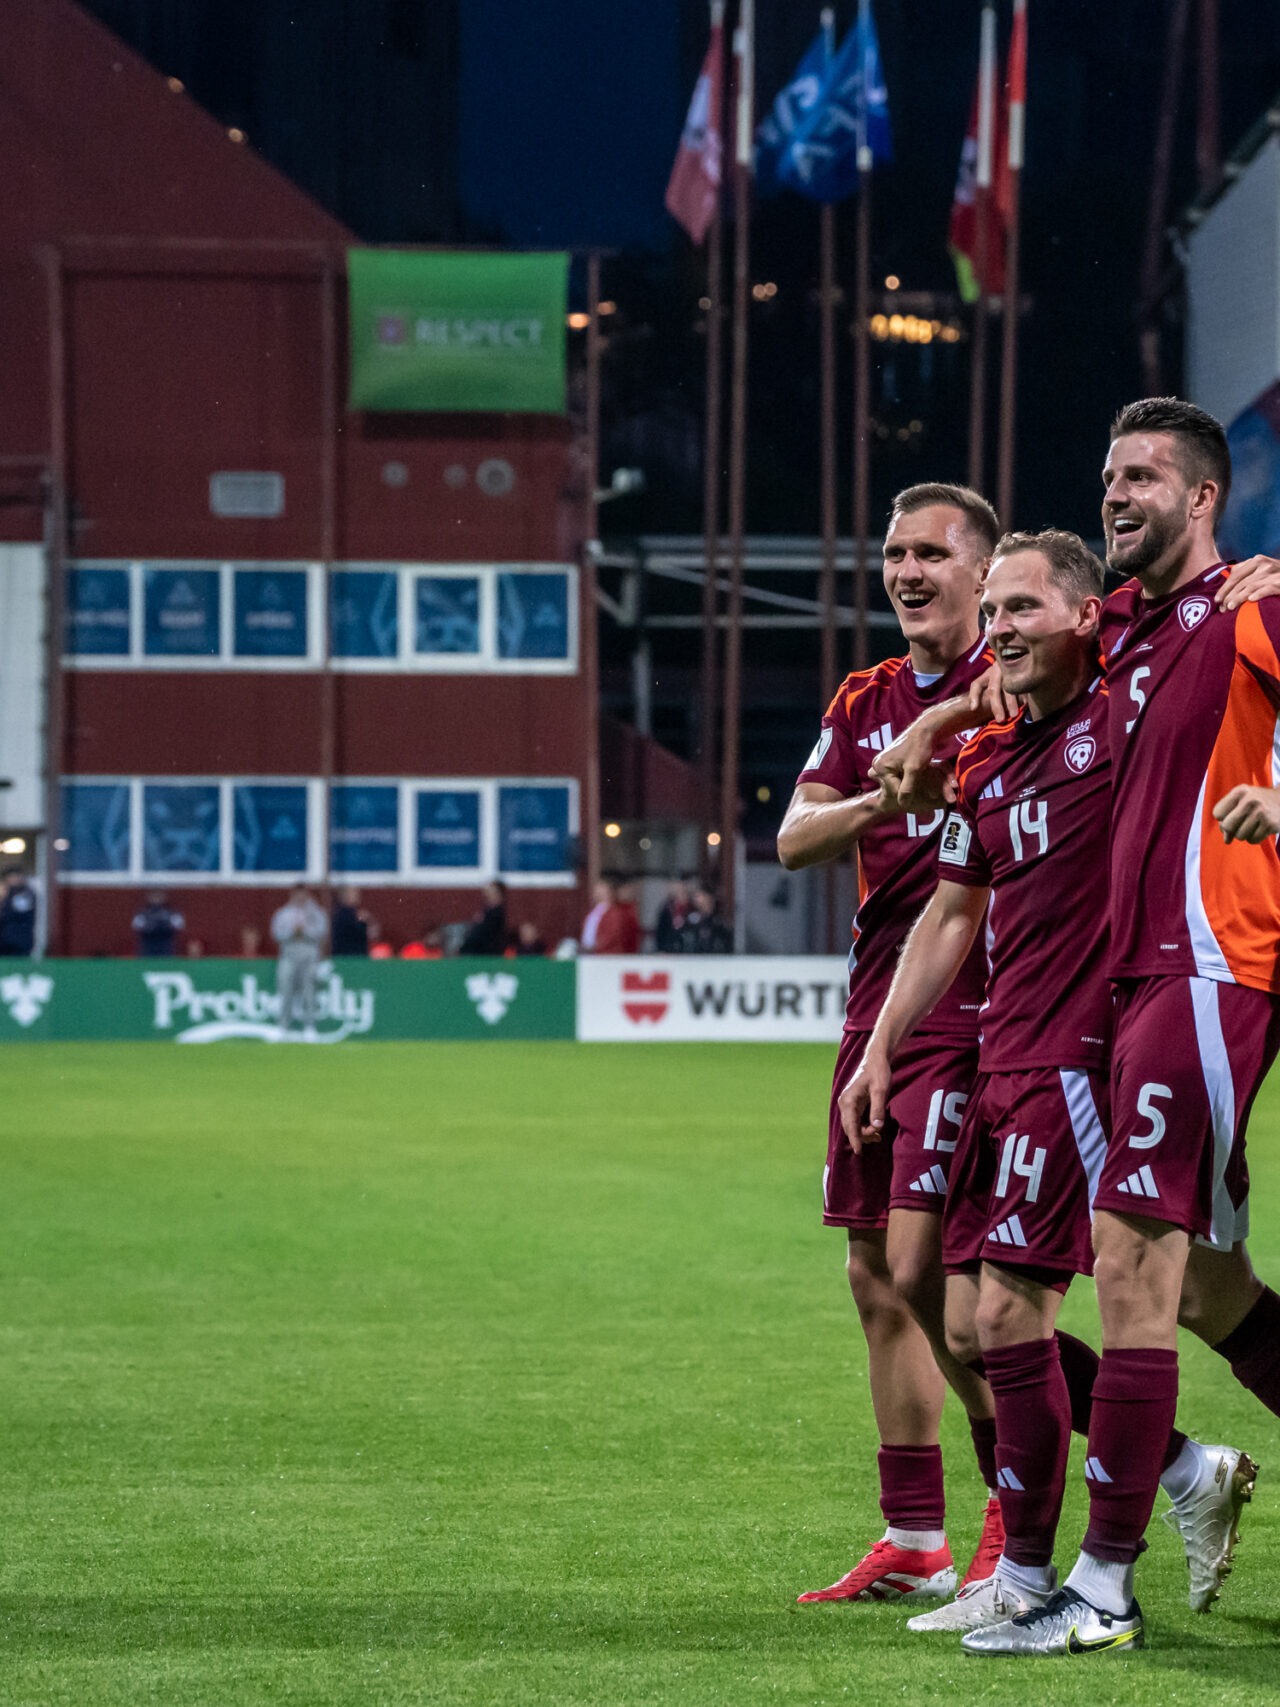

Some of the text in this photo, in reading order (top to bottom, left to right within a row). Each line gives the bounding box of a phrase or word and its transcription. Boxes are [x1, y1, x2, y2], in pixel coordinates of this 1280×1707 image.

[1126, 665, 1151, 734] 5
[1009, 799, 1049, 862] 14
[923, 1089, 968, 1153] 15
[1128, 1082, 1173, 1150] 5
[994, 1132, 1047, 1203] 14
